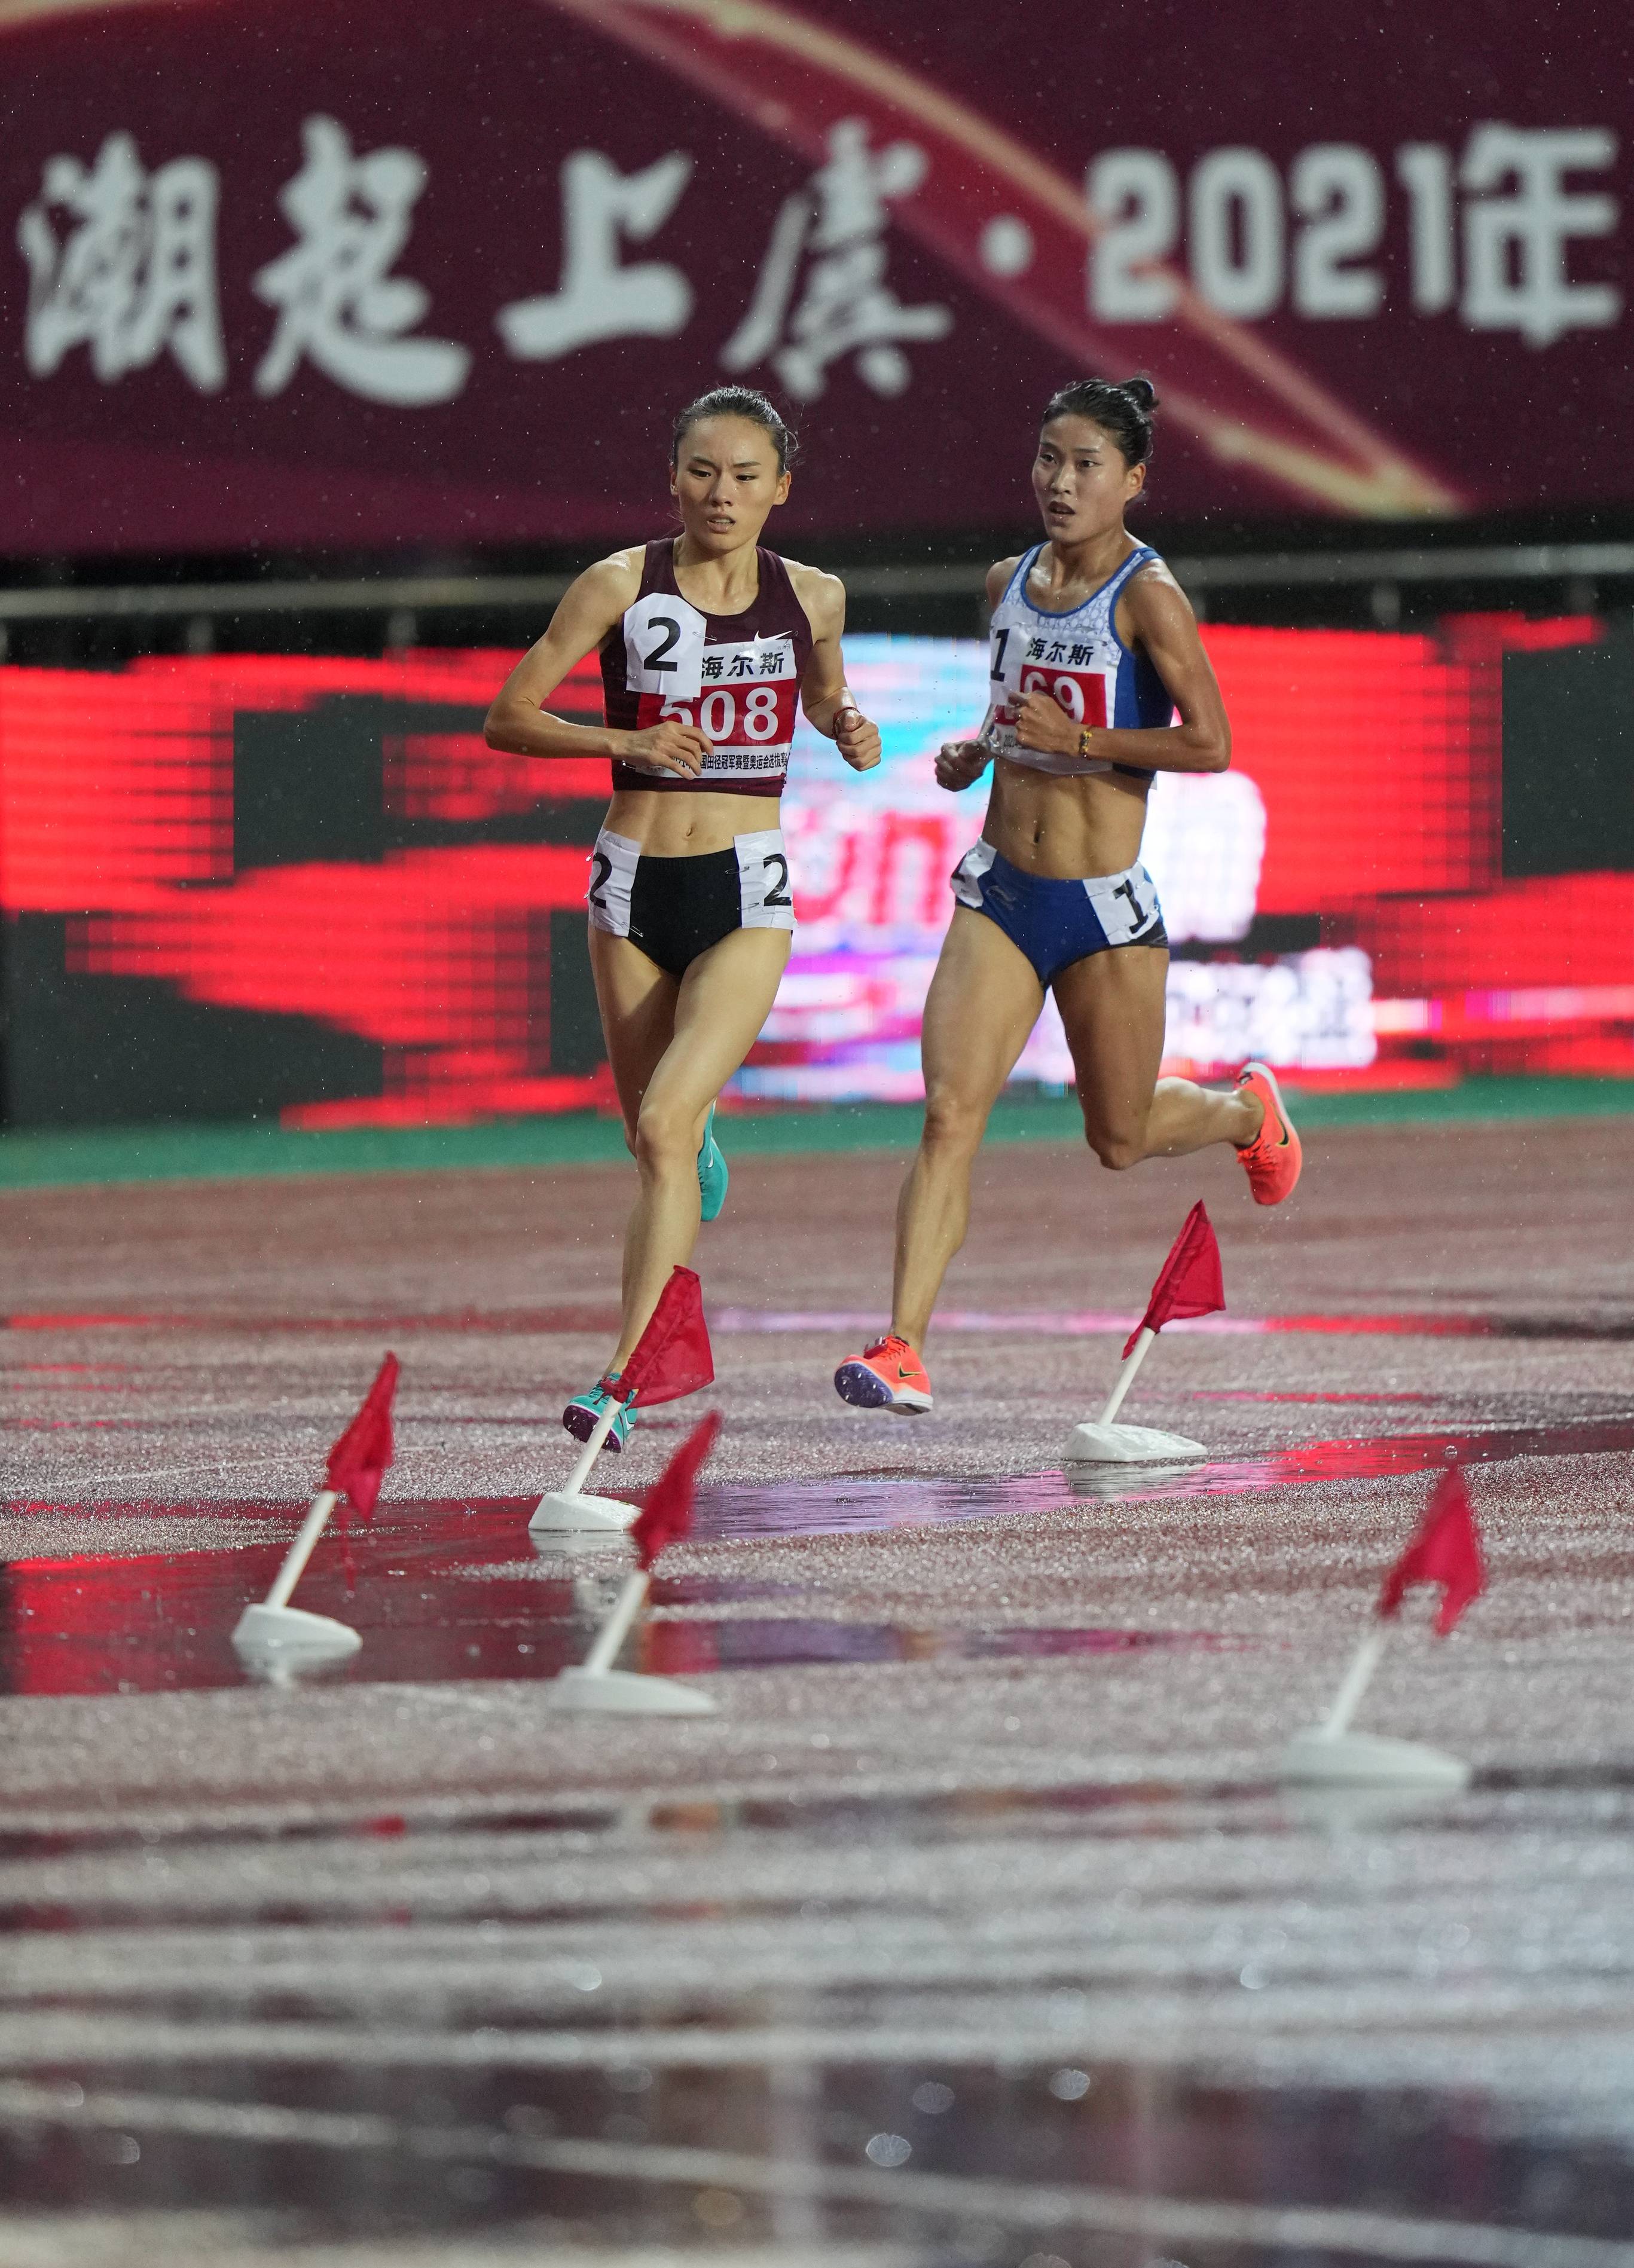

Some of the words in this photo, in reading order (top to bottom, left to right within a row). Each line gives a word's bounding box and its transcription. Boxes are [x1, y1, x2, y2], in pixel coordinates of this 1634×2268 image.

[643, 617, 681, 672] 2
[701, 652, 784, 679] 海尔斯
[991, 629, 1010, 682] 1
[1025, 638, 1095, 666] 海尔斯
[659, 687, 778, 741] 508
[590, 852, 613, 909] 2
[763, 854, 792, 906] 2
[1113, 879, 1149, 934] 1
